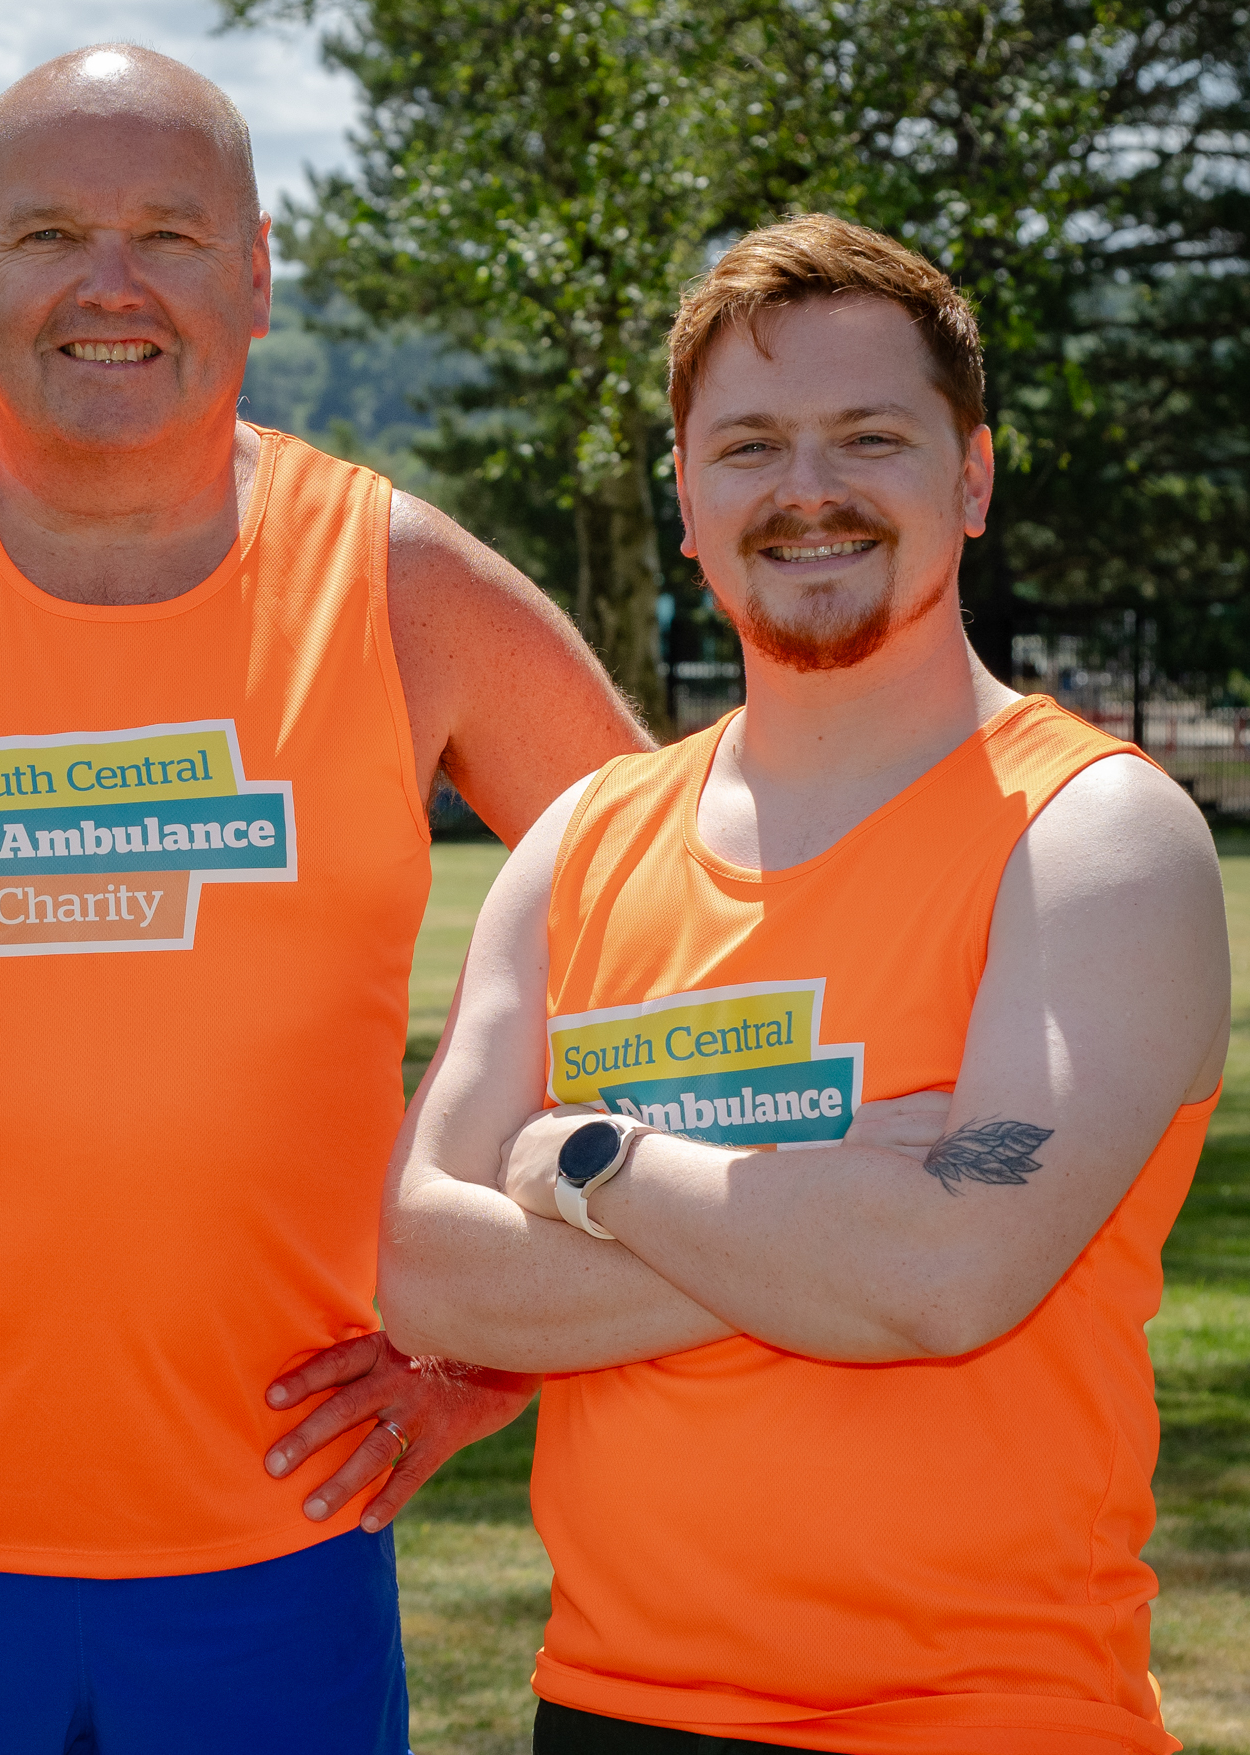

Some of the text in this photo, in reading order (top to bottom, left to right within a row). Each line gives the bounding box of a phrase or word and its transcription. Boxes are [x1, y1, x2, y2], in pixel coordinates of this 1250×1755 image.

[66, 750, 213, 792] Central
[564, 1011, 794, 1081] South Central
